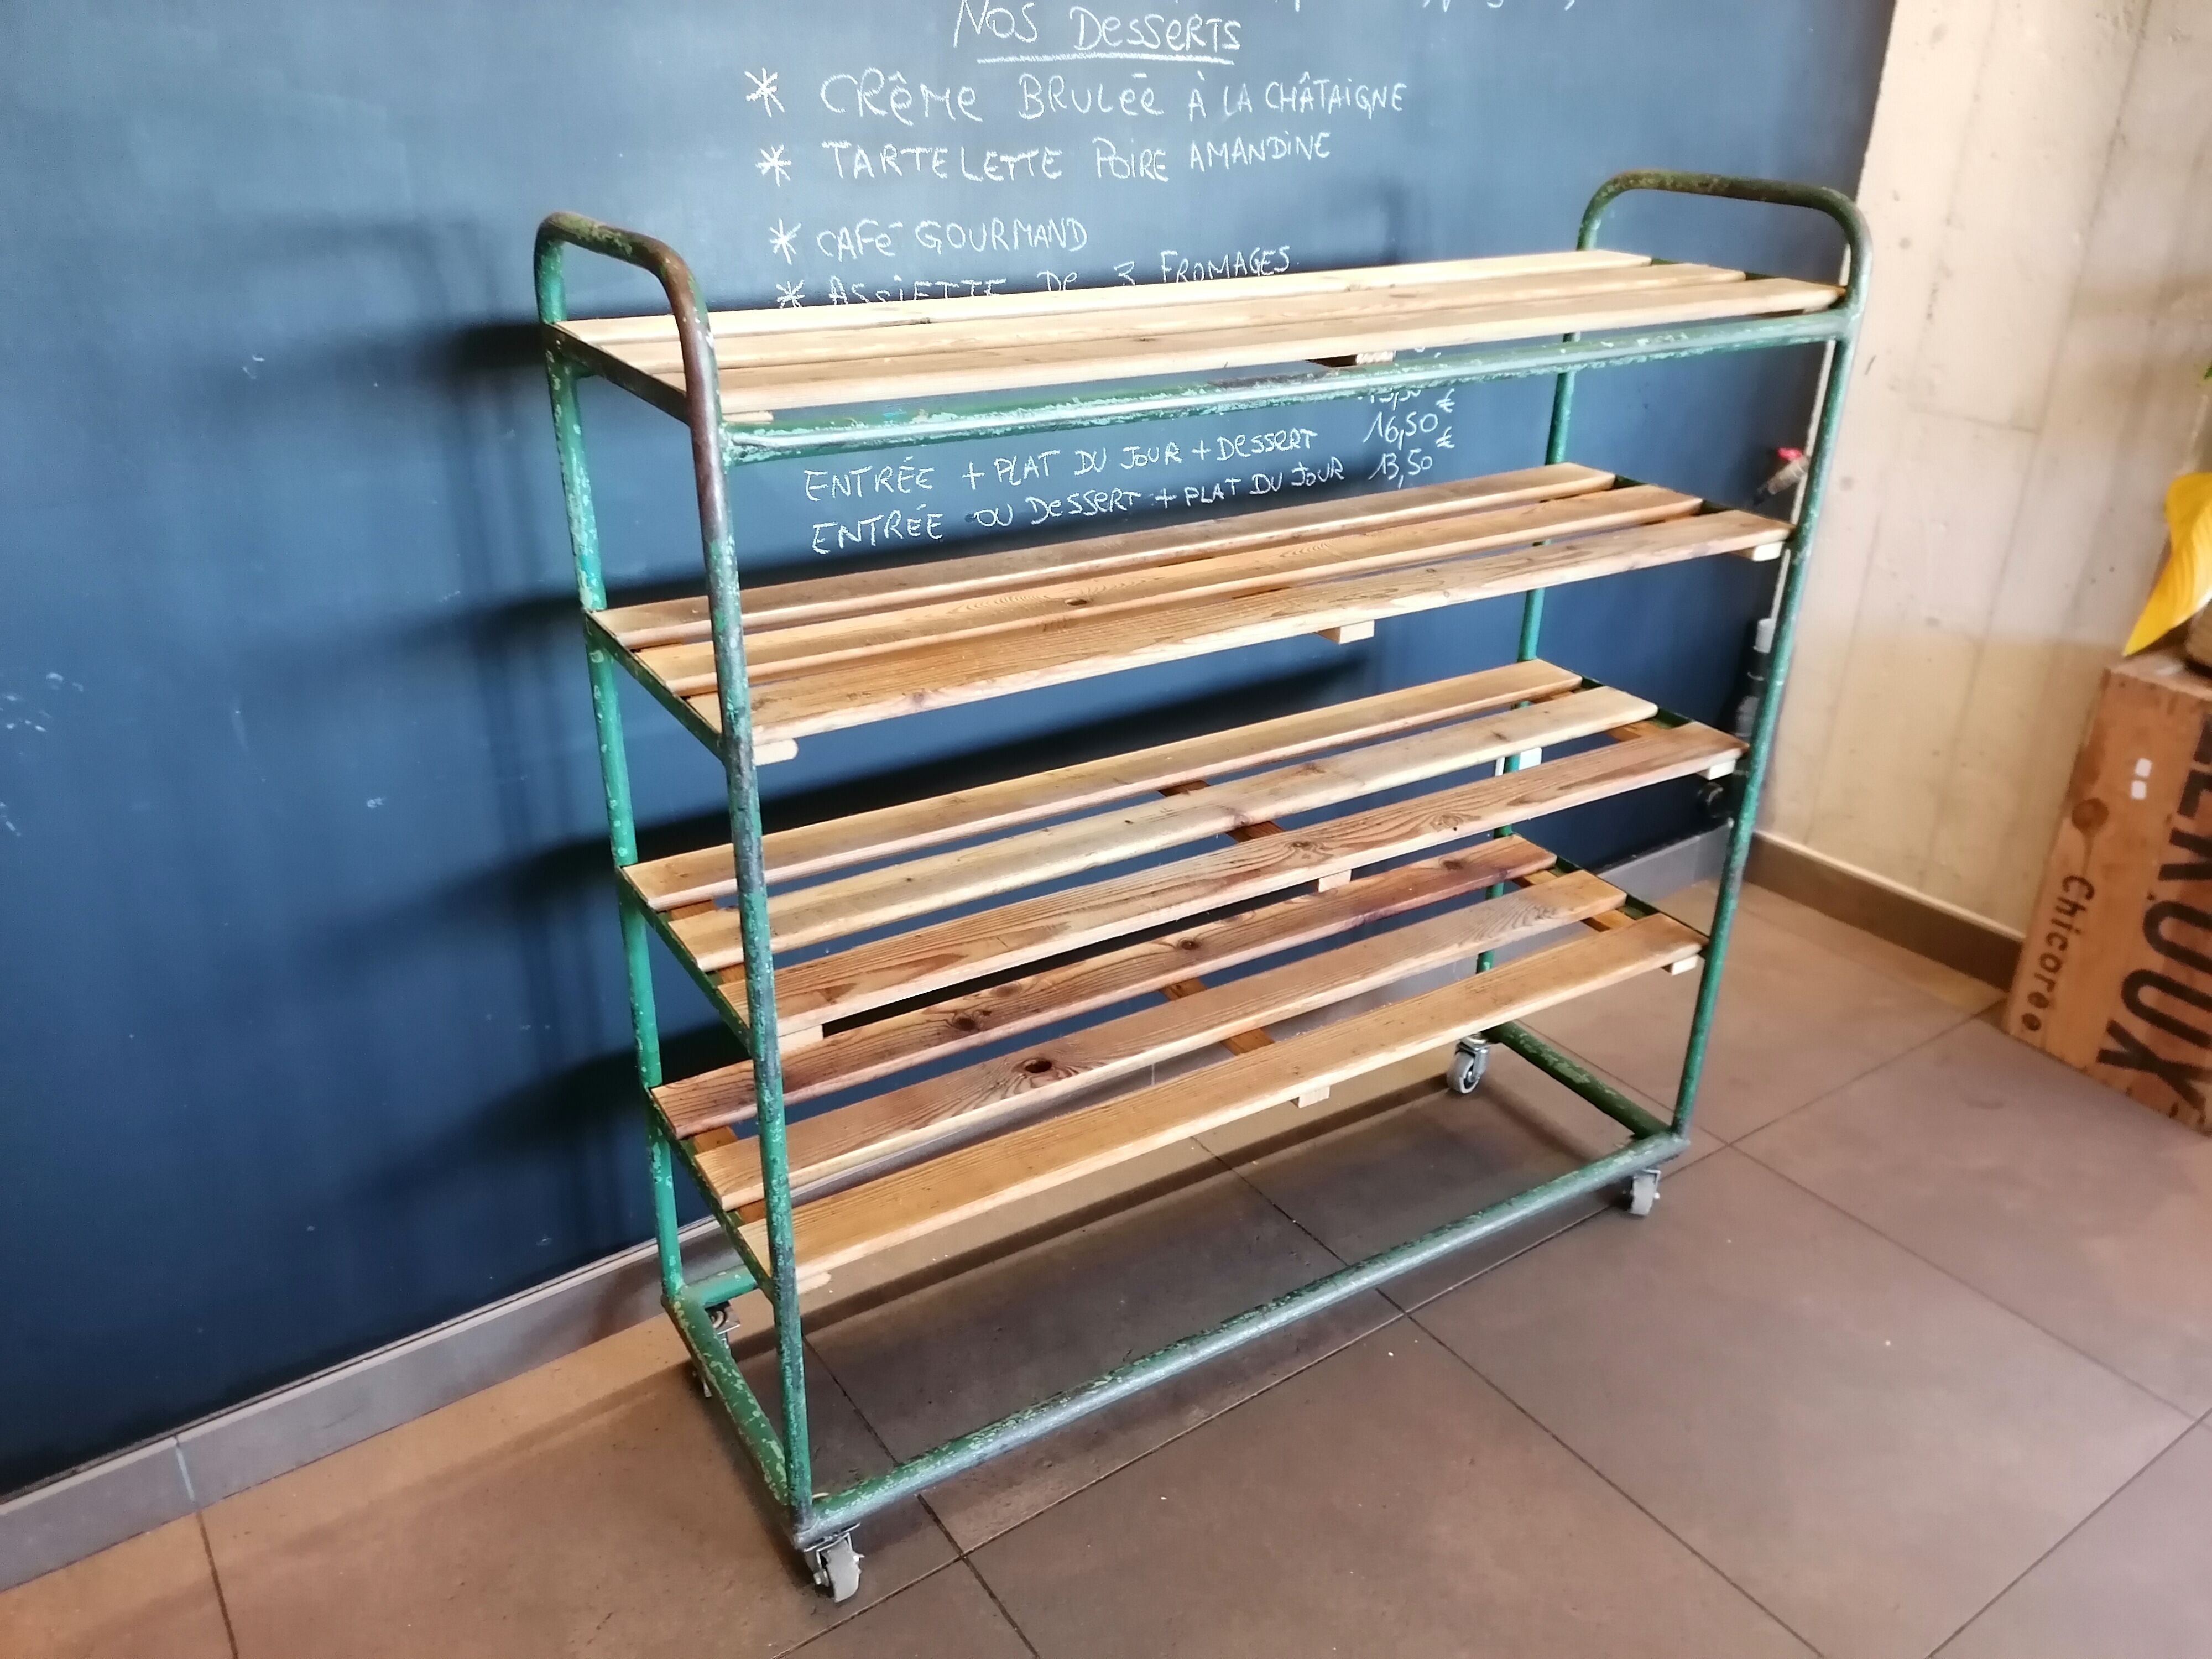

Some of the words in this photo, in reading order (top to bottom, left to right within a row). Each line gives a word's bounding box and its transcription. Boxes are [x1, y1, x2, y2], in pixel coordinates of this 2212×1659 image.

[1223, 83, 1253, 117] LA
[821, 140, 1063, 182] TARTELETTE
[915, 217, 1087, 255] GOURMAND
[1114, 260, 1135, 285] 3
[804, 456, 935, 501] ENTRÉE
[962, 462, 985, 491] +
[993, 450, 1061, 486] PLAT
[1074, 447, 1107, 476] DU
[1120, 441, 1183, 469] JOUR
[1192, 440, 1212, 461] +
[1363, 411, 1438, 451] 16,50
[811, 503, 943, 555] ENTRÉE
[974, 507, 1013, 527] OU
[1154, 488, 1178, 509] +
[1184, 477, 1241, 507] PLAT
[1249, 471, 1283, 495] DU
[1291, 456, 1344, 487] JOUR
[1368, 448, 1433, 489] 13,50
